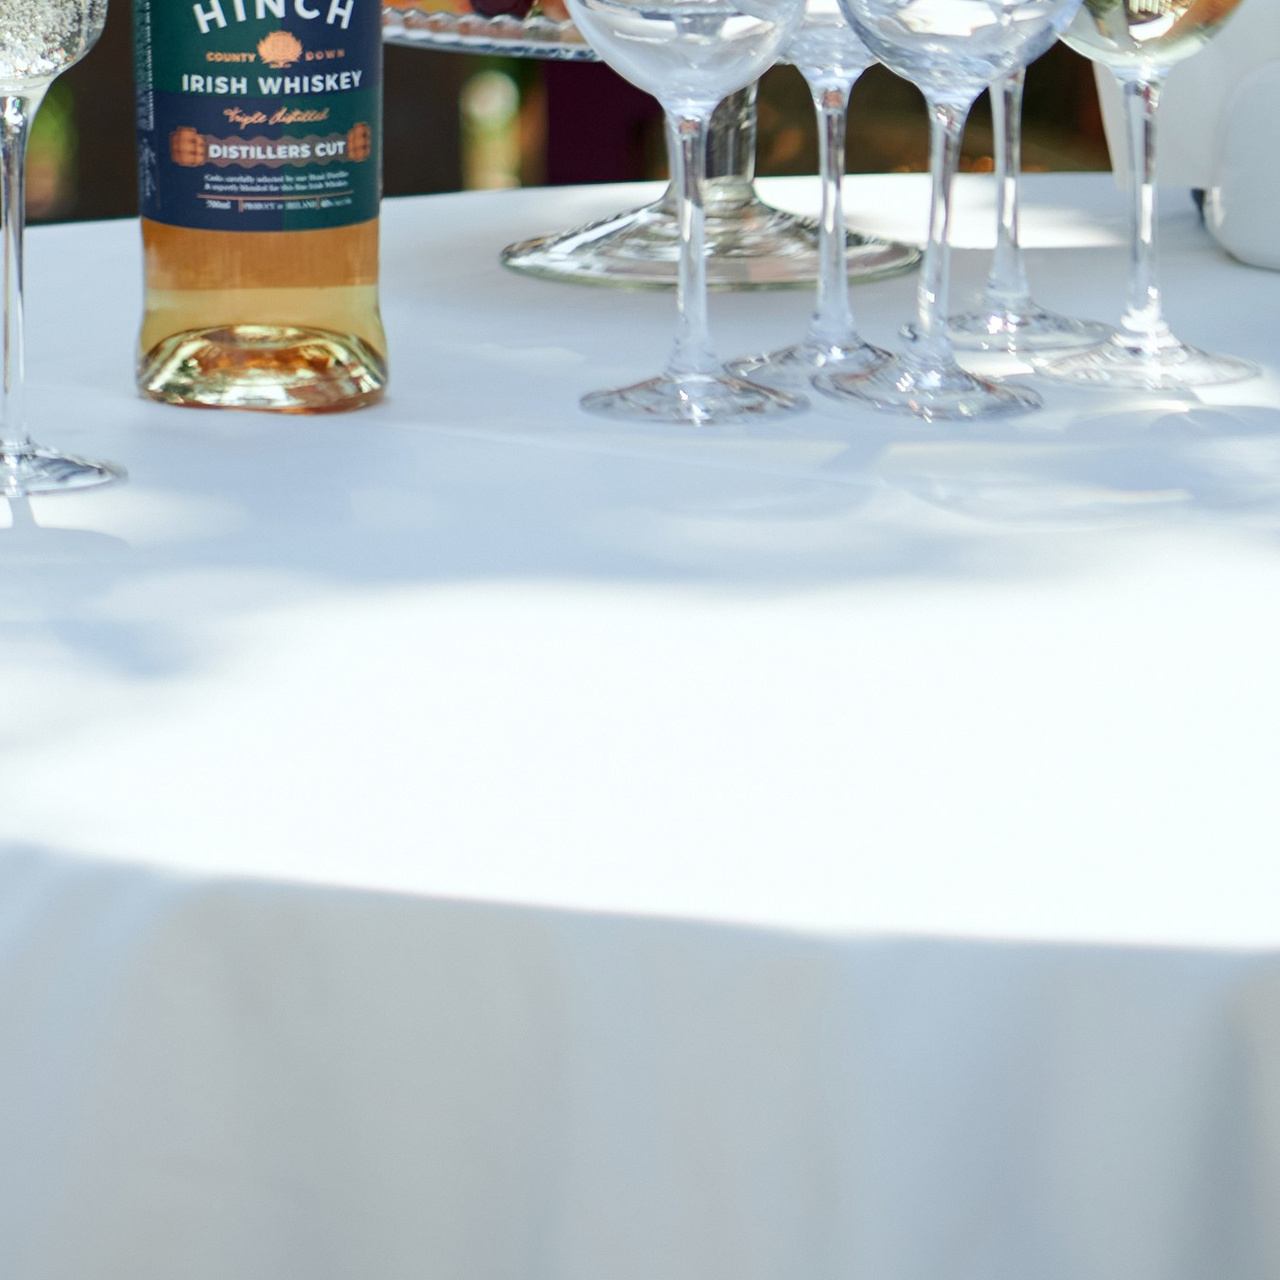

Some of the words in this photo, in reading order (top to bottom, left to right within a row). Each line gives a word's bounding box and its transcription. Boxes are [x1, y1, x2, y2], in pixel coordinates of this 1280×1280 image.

[206, 51, 256, 63] COUNTY
[305, 49, 346, 61] DOWN
[182, 73, 247, 94] IRISH
[258, 70, 362, 95] WHISKEY
[208, 144, 311, 159] DISTILLERS
[314, 141, 347, 158] CUT
